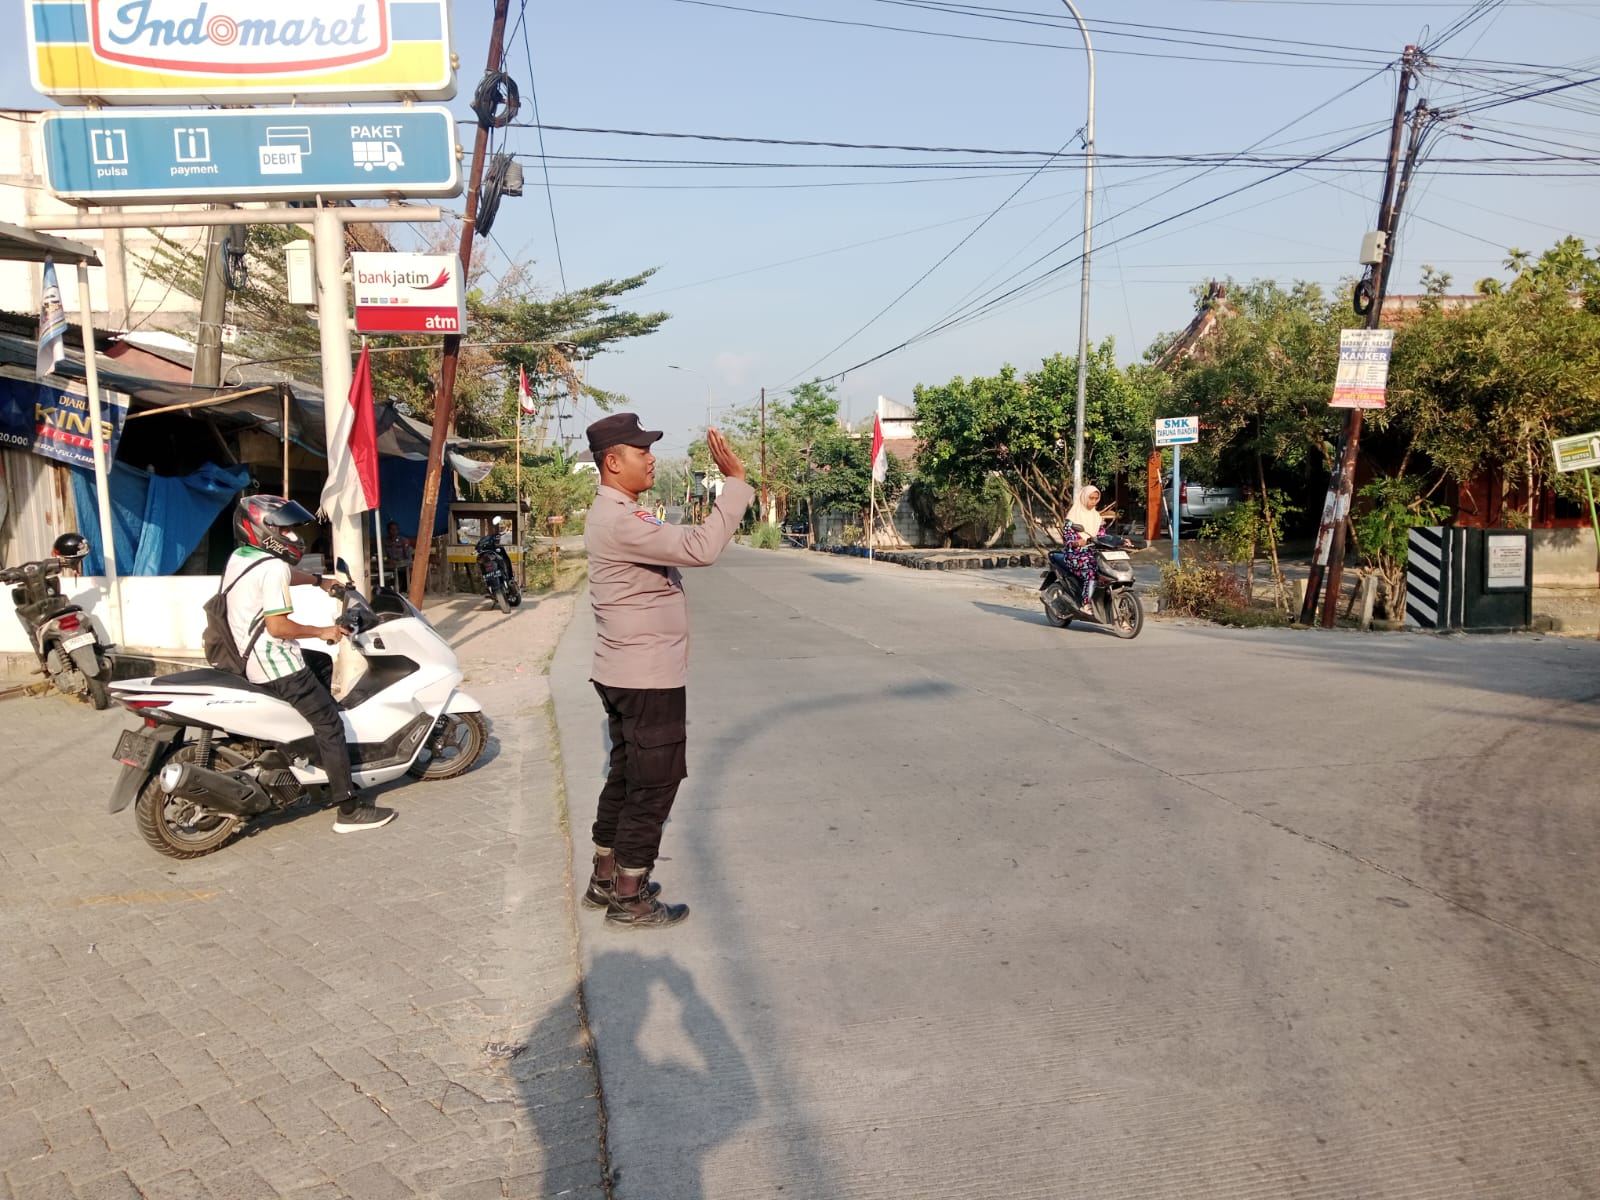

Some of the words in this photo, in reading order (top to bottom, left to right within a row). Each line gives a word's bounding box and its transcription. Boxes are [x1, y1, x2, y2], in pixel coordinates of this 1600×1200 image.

[109, 0, 368, 46] Indomaret
[351, 125, 403, 139] PAKET
[263, 152, 297, 166] DEBIT
[97, 167, 128, 178] pulsa
[170, 163, 219, 177] payment
[425, 314, 456, 329] atm
[1341, 352, 1387, 361] KANKER
[1164, 418, 1189, 428] SMK
